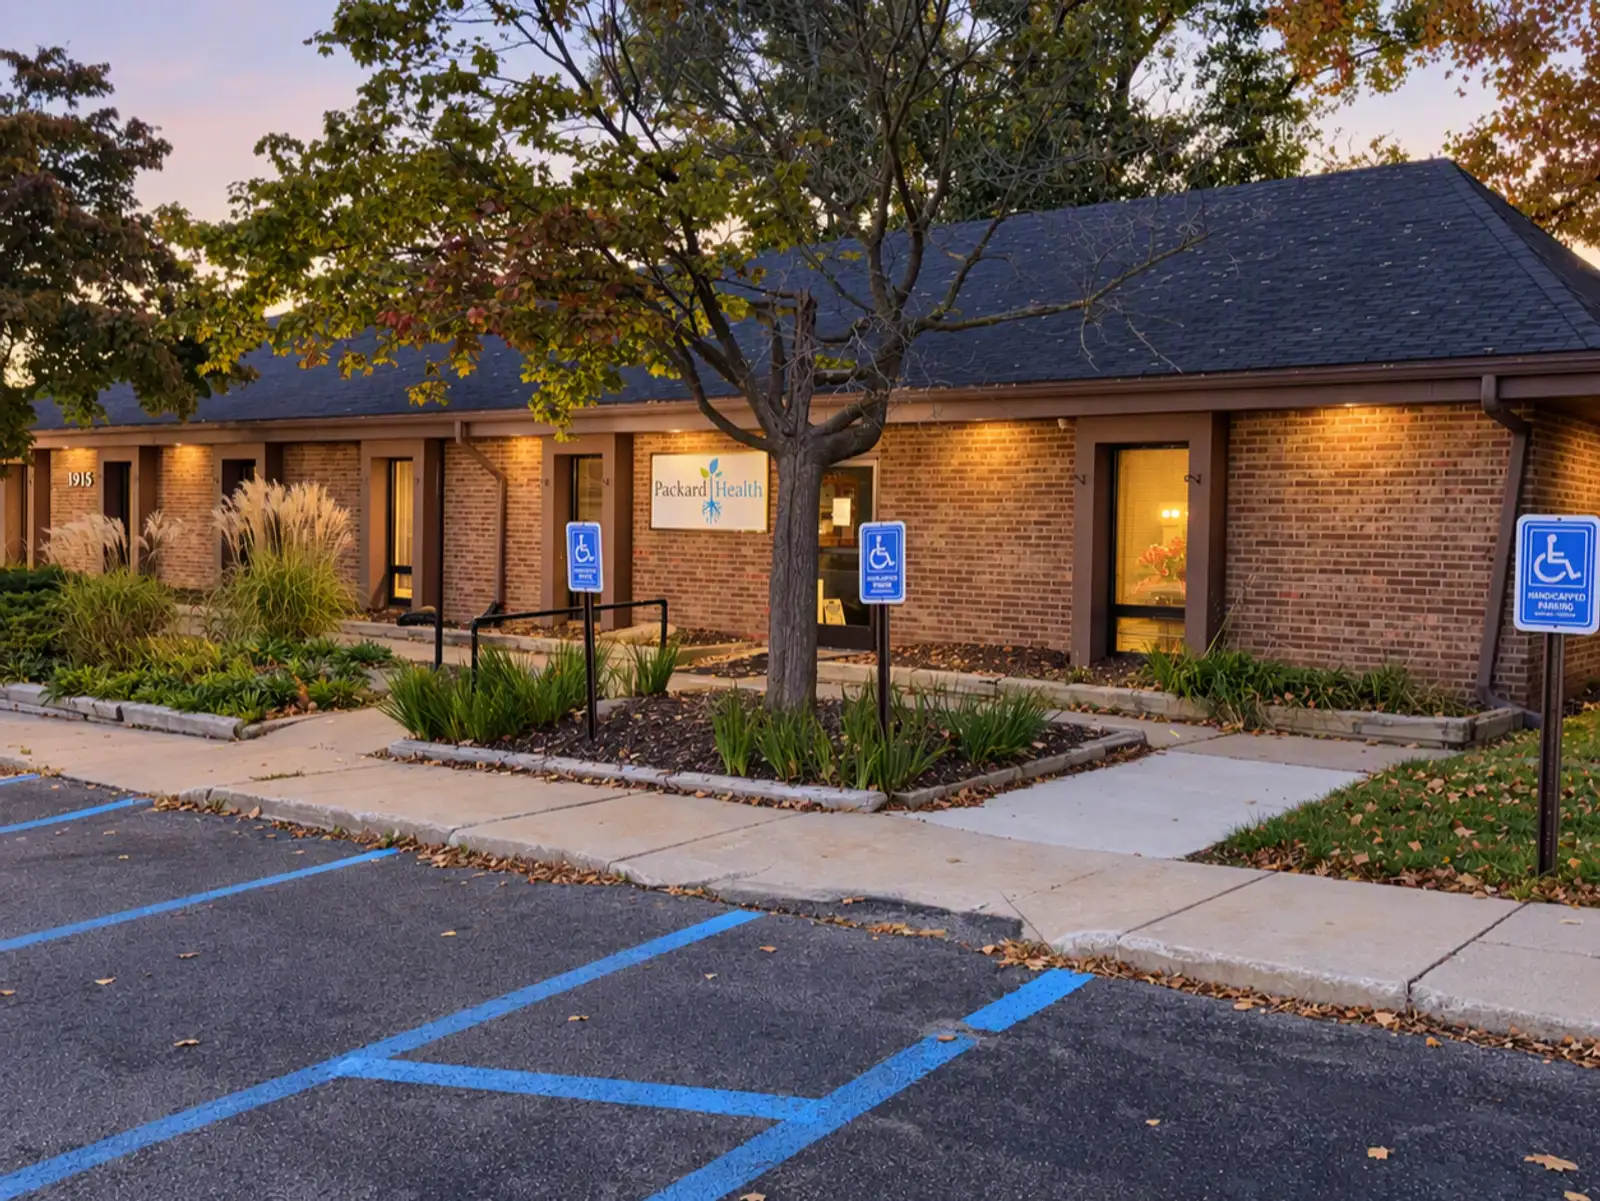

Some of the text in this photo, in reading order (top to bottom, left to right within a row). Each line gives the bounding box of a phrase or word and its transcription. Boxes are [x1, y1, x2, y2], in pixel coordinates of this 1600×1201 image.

[68, 472, 92, 487] 1915
[654, 480, 762, 498] Packard Health
